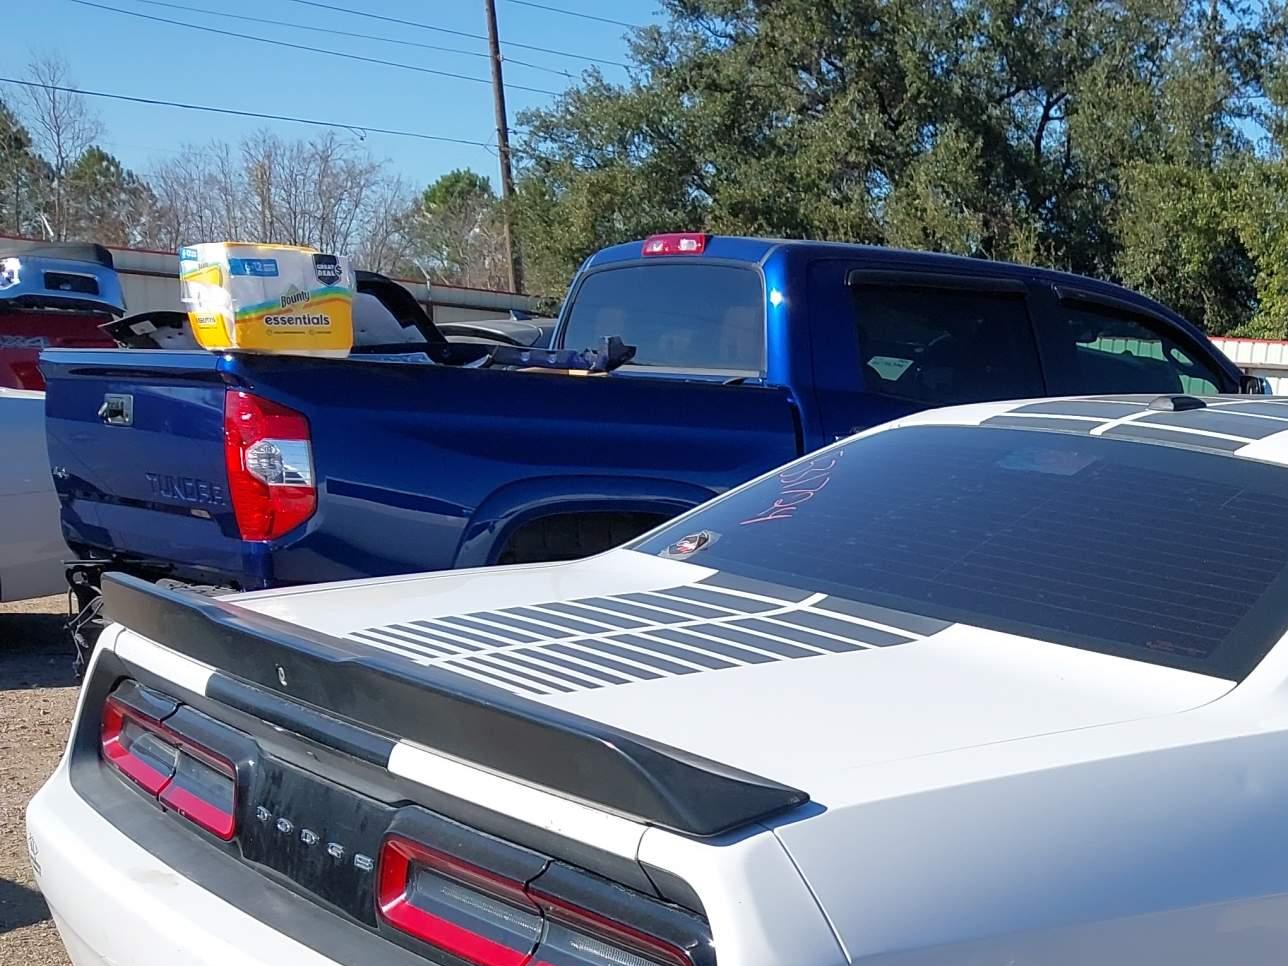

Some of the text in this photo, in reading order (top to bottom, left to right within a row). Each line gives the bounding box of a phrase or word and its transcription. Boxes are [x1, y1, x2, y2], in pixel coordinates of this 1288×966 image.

[280, 290, 311, 309] Bounty
[264, 313, 331, 326] essentials
[145, 472, 227, 506] TUNDRA
[256, 805, 375, 872] DODGE
